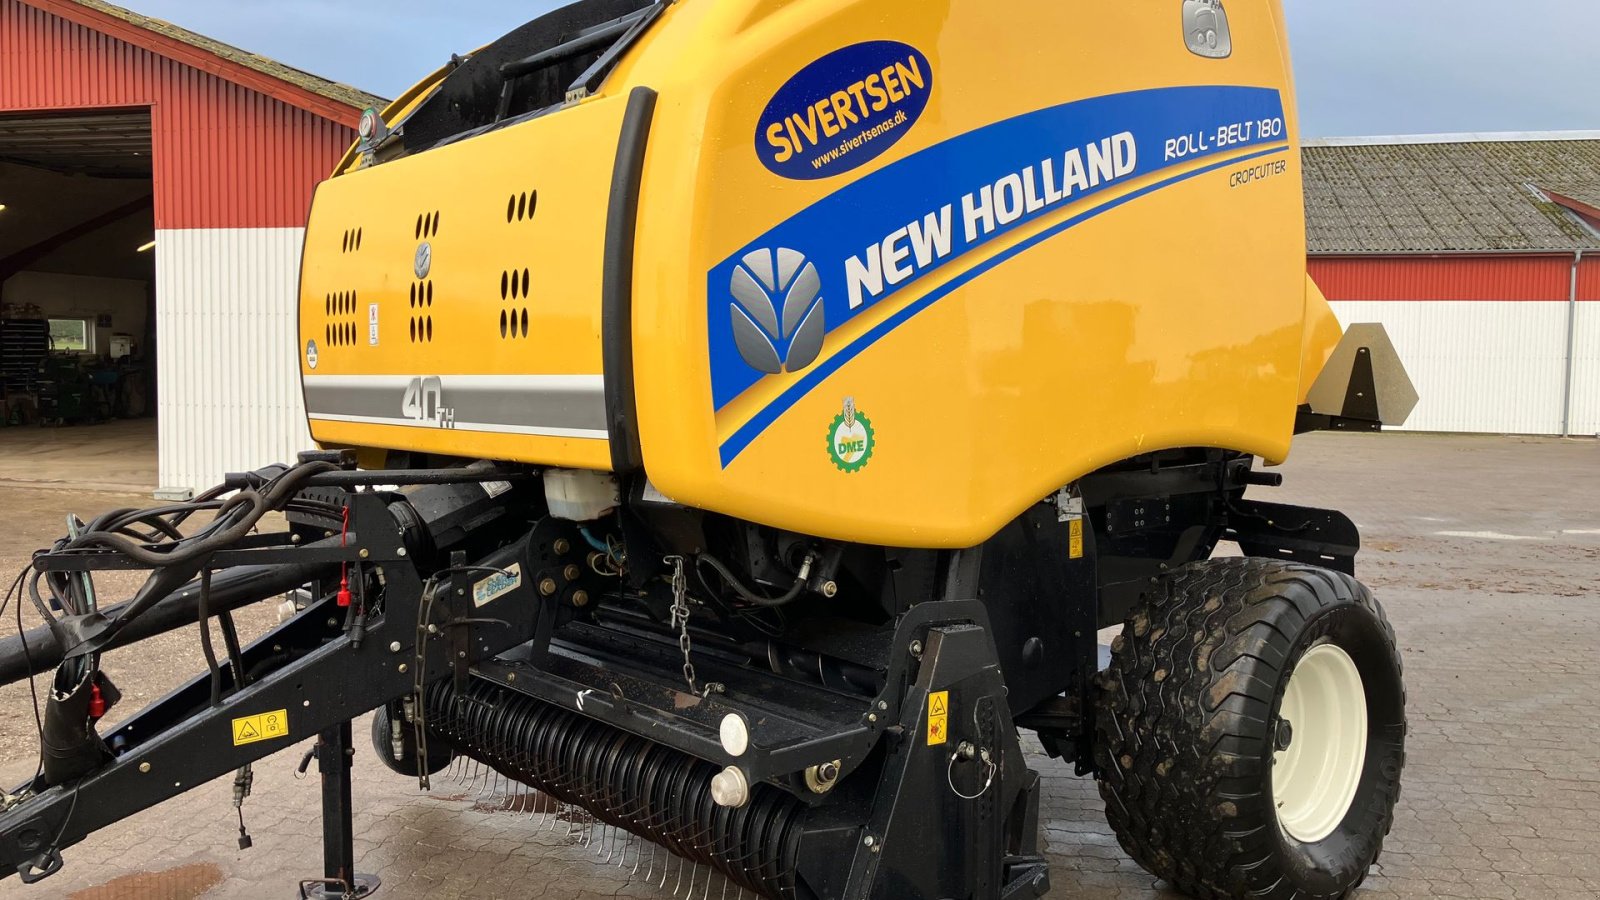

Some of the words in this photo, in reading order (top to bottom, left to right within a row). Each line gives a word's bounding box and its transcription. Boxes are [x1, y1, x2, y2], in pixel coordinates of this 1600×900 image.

[766, 55, 924, 163] SIVERTSEN
[811, 109, 908, 169] www.sivertsenas.dk
[1164, 121, 1253, 162] ROLL-BELT
[1256, 117, 1281, 139] 180
[1229, 159, 1286, 188] CROPCUTTER
[844, 203, 952, 310] NEW
[961, 131, 1137, 243] HOLLAND
[838, 440, 864, 455] DME
